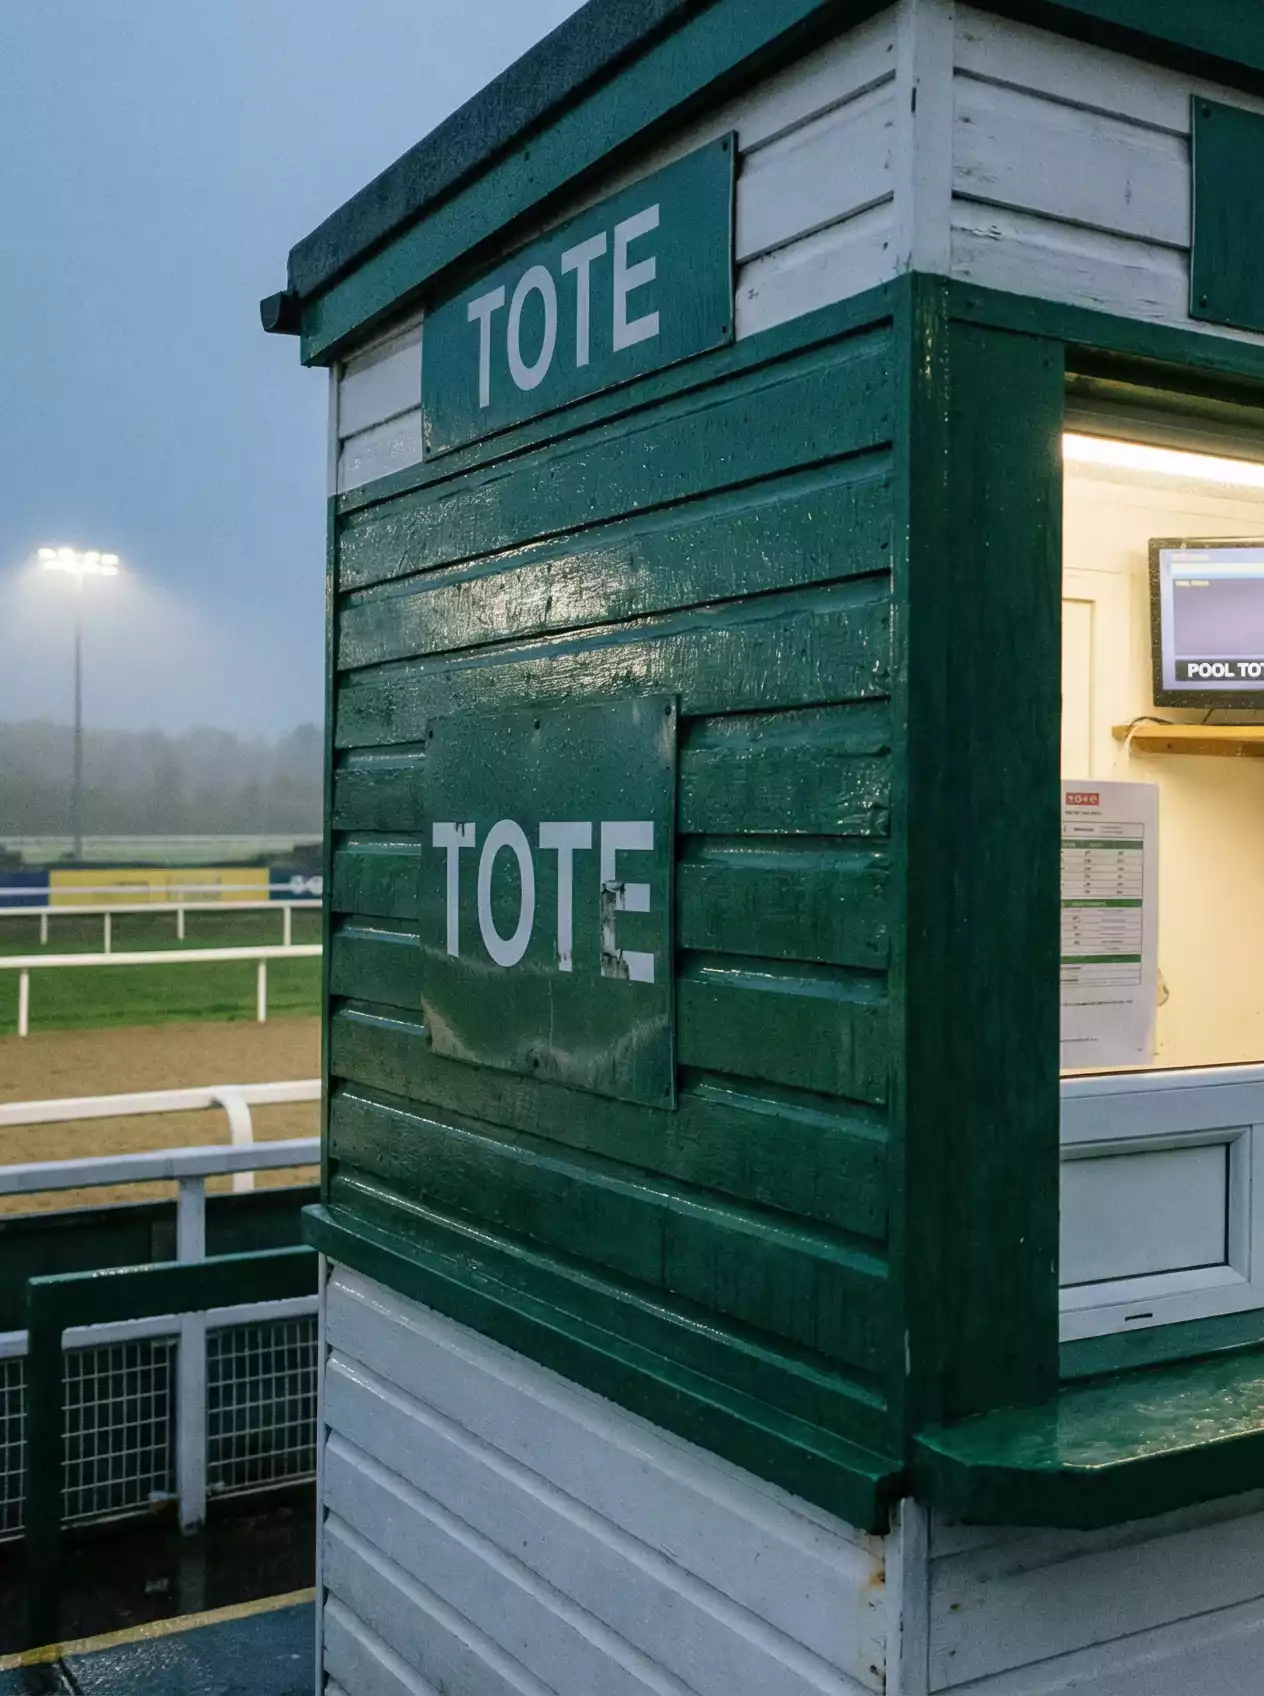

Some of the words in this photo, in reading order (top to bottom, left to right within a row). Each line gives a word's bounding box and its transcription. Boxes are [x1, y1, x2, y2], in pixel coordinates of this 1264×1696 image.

[467, 202, 660, 409] TOTE
[1187, 662, 1235, 678] POOL
[432, 818, 655, 984] TOTE
